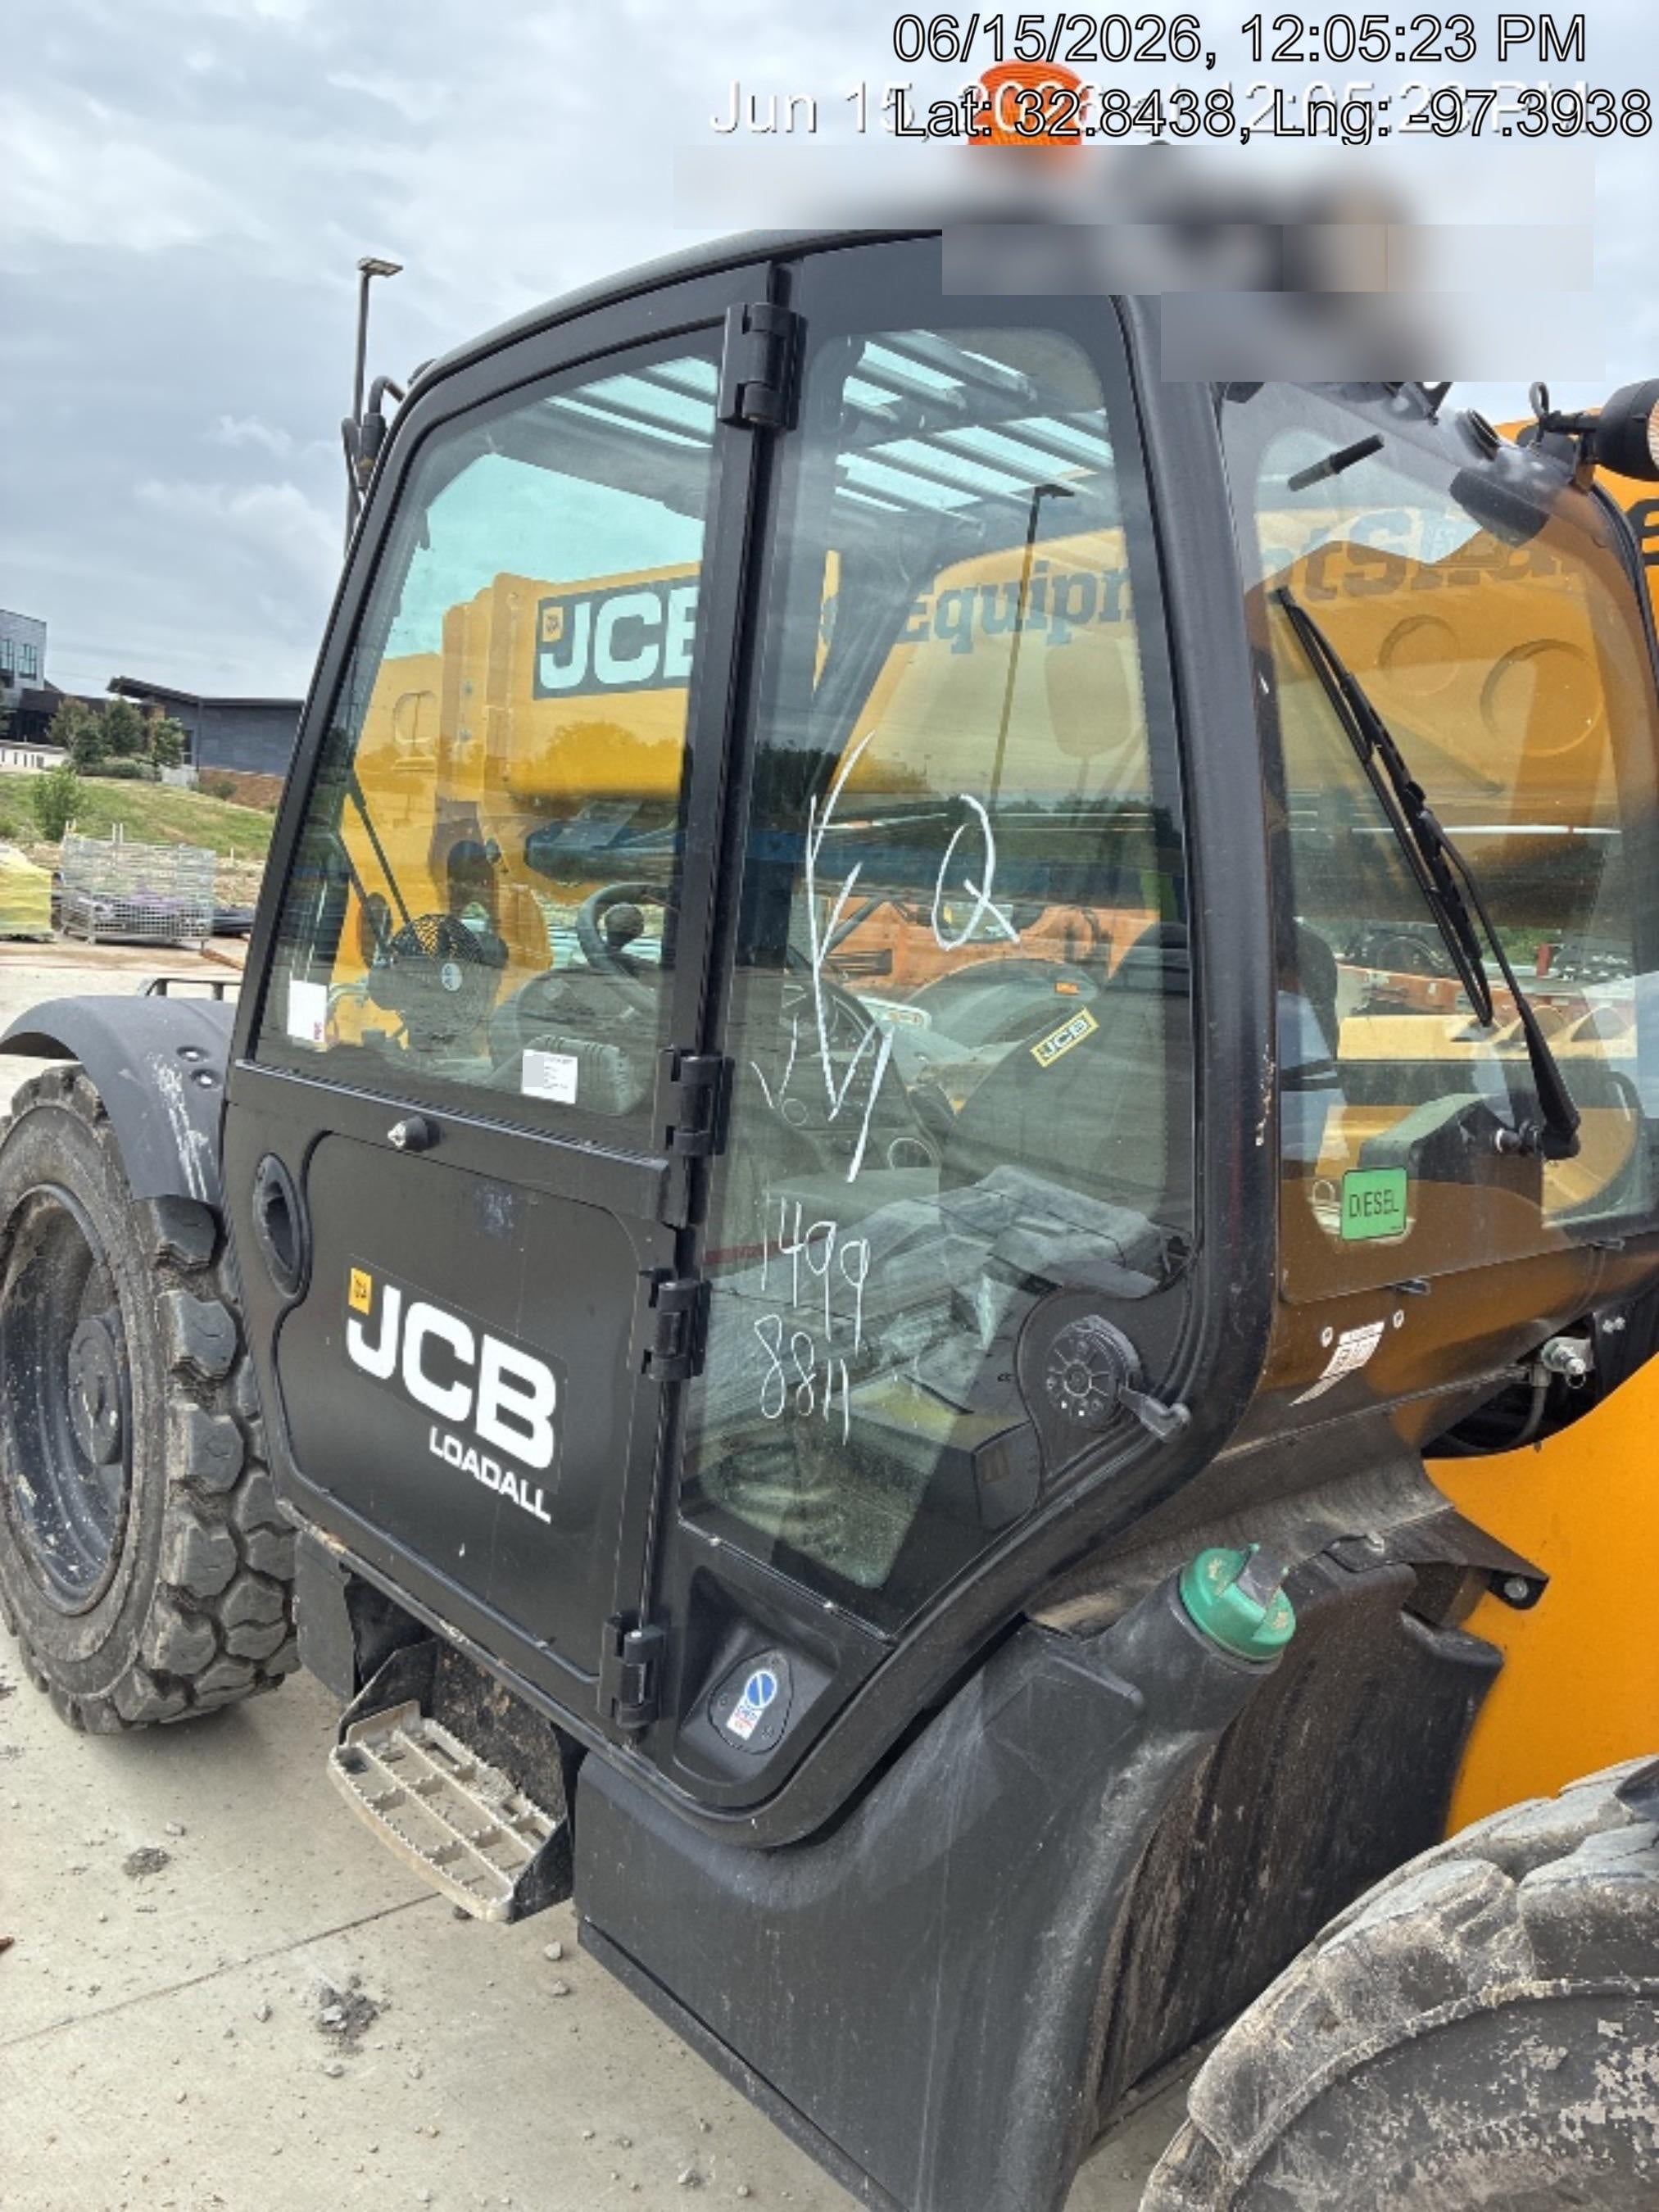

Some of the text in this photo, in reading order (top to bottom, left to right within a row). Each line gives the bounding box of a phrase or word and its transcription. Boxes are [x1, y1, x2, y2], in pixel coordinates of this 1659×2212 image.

[1041, 1018, 1088, 1057] JCB
[1349, 1189, 1399, 1218] DIESEL
[346, 1284, 556, 1469] JCB
[429, 1426, 551, 1524] LOADALL
